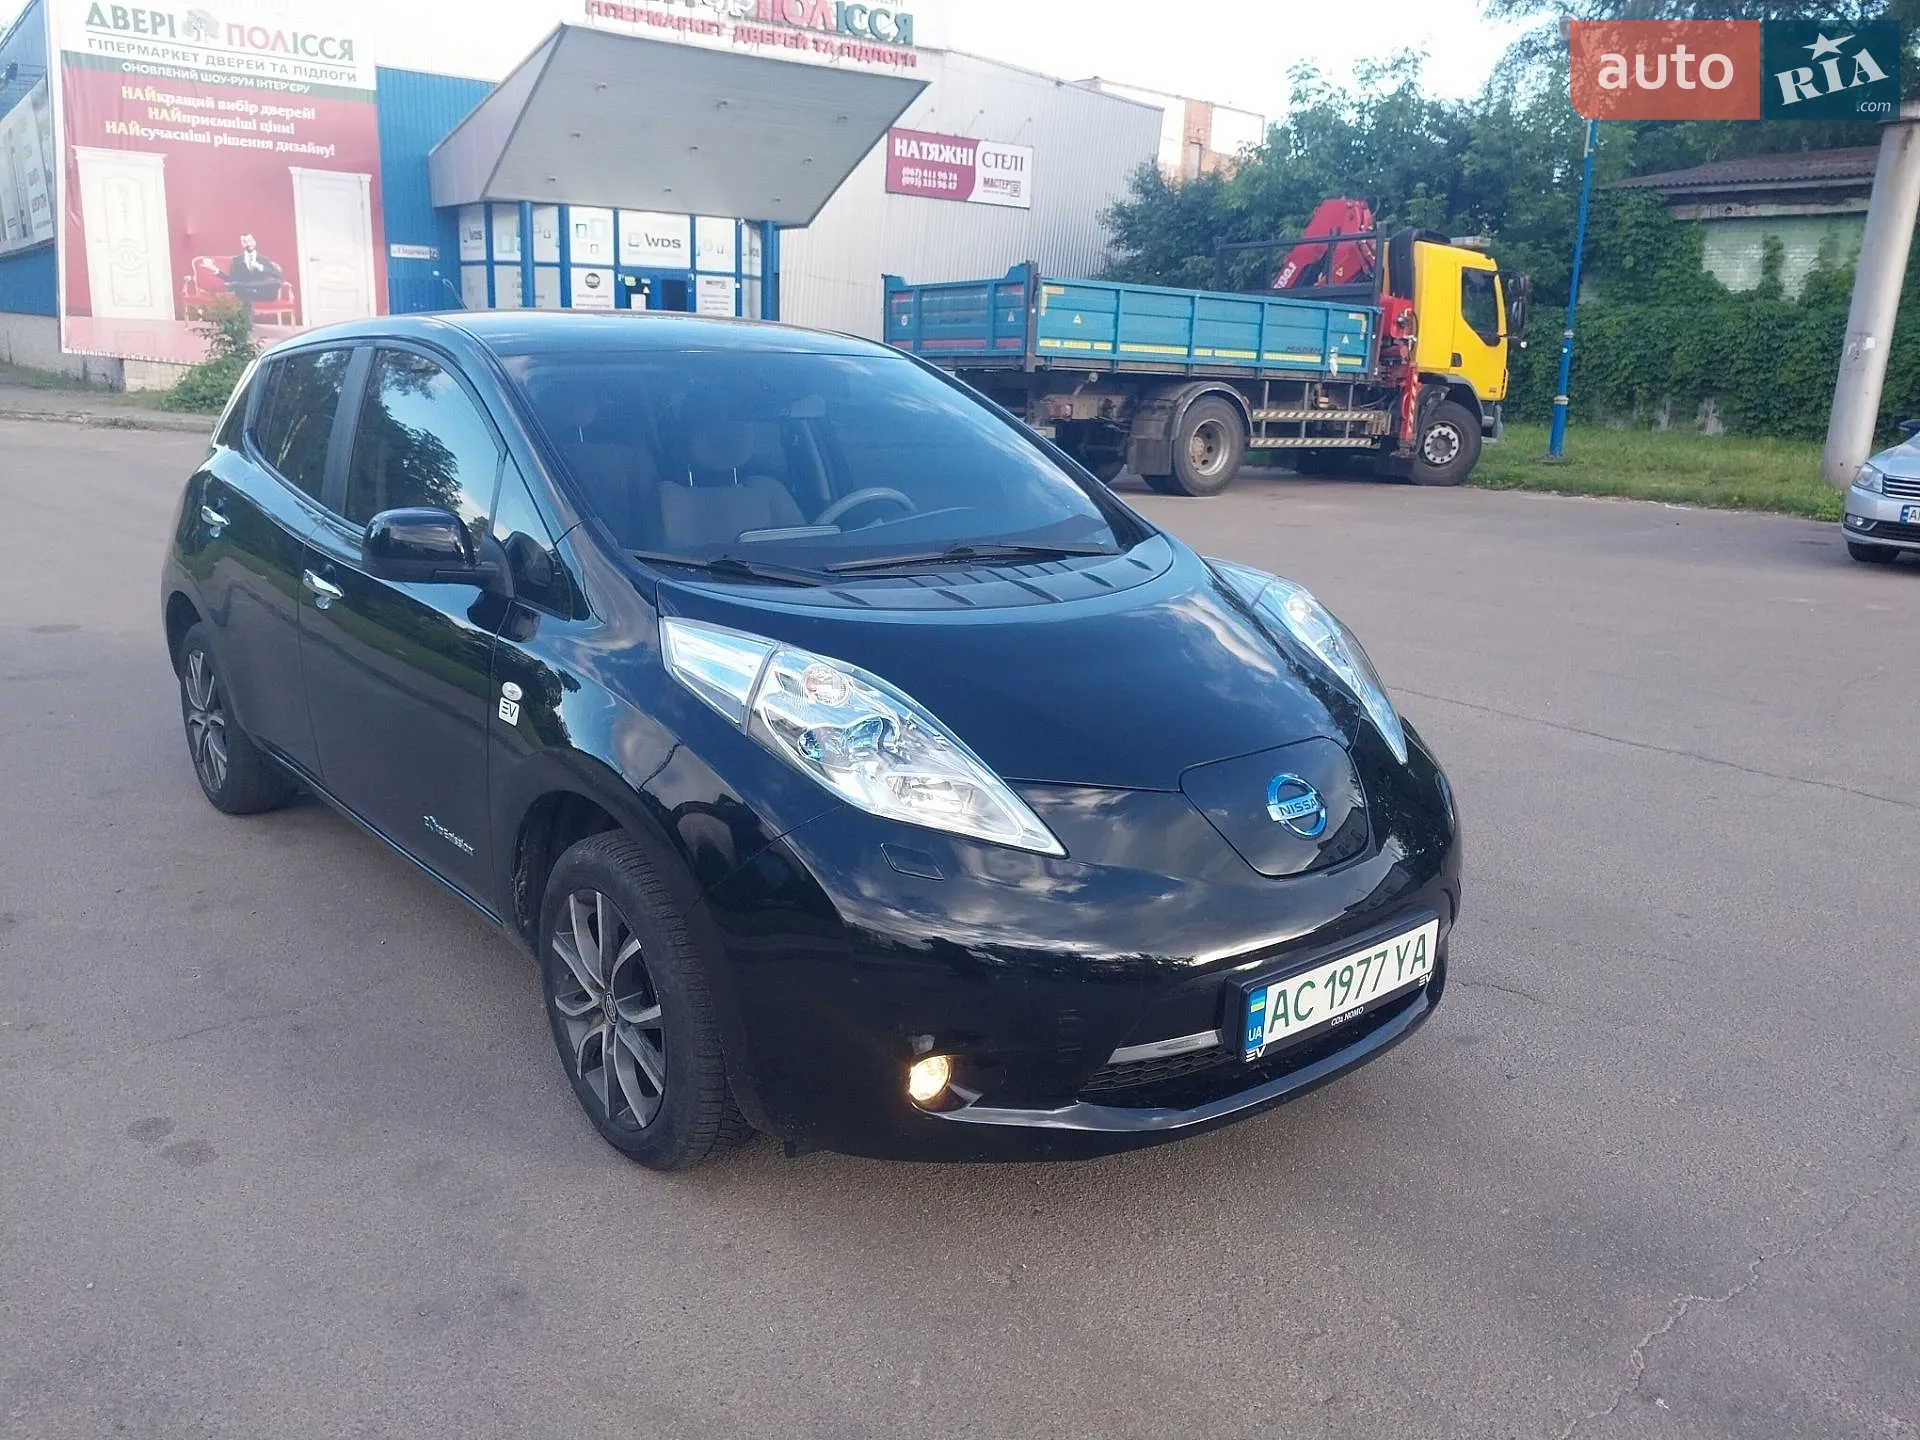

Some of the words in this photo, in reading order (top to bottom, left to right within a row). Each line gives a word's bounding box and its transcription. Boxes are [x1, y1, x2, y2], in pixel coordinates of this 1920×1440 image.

[85, 1, 177, 38] ДВЕРІ
[224, 22, 355, 61] ПОЛІССЯ
[585, 0, 727, 36] ГІПЕРМАРКЕТ
[733, 26, 809, 50] ДВЕРЕЙ
[813, 37, 834, 54] ТА
[838, 43, 917, 68] ПІДЛОГИ
[759, 0, 914, 45] ПОЛІССЯ
[88, 37, 200, 63] ГІПЕРМАРКЕТ
[205, 55, 265, 72] ДВЕРЕЙ
[269, 62, 289, 75] ТА
[292, 65, 358, 83] ПІДЛОГИ
[122, 62, 198, 80] ОНОВЛЕНИЙ
[200, 72, 254, 88] ШОУ-РУМ
[121, 85, 215, 109] НАЙкращий
[217, 99, 258, 116] вибір
[260, 105, 316, 120] дверей!
[148, 107, 257, 131] НАЙприємніші
[260, 119, 295, 134] ціни!
[105, 120, 211, 144] НАЙсучасніші
[213, 135, 273, 151] рішення
[275, 140, 335, 158] дизайну!
[894, 138, 974, 166] НАТЯЖНІ
[982, 152, 1024, 172] СТЕЛІ
[645, 233, 682, 249] WDS
[1910, 509, 1920, 520] A
[502, 700, 517, 718] EV
[1278, 798, 1318, 816] NISSA
[1268, 980, 1316, 1033] AC
[1323, 949, 1388, 1011] 1977
[1396, 933, 1426, 981] YA
[1248, 1025, 1262, 1042] UA
[1245, 1045, 1266, 1062] EV
